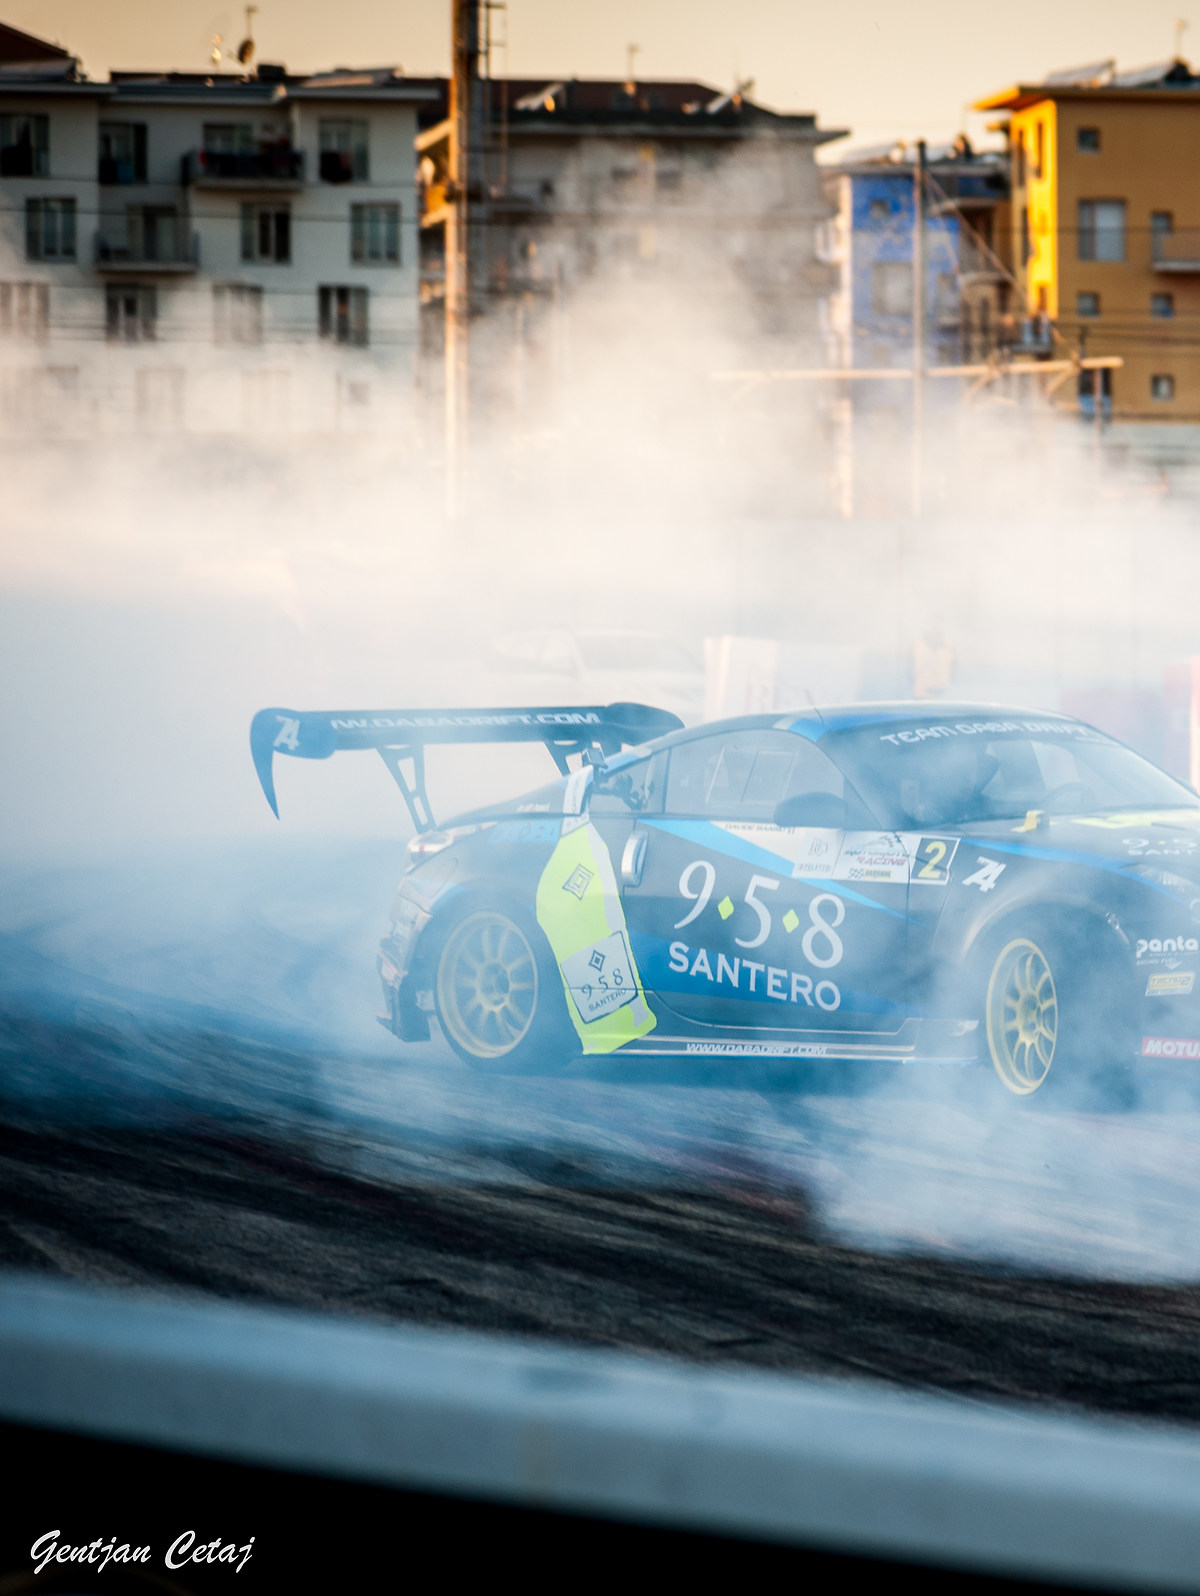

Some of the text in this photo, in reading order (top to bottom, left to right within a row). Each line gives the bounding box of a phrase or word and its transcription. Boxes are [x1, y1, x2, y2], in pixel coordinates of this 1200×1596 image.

[331, 713, 601, 728] W.DABADRIFT.COM
[879, 727, 958, 746] TEAM
[917, 841, 947, 879] 2
[1136, 935, 1199, 959] panta
[668, 941, 842, 1012] SANTERO
